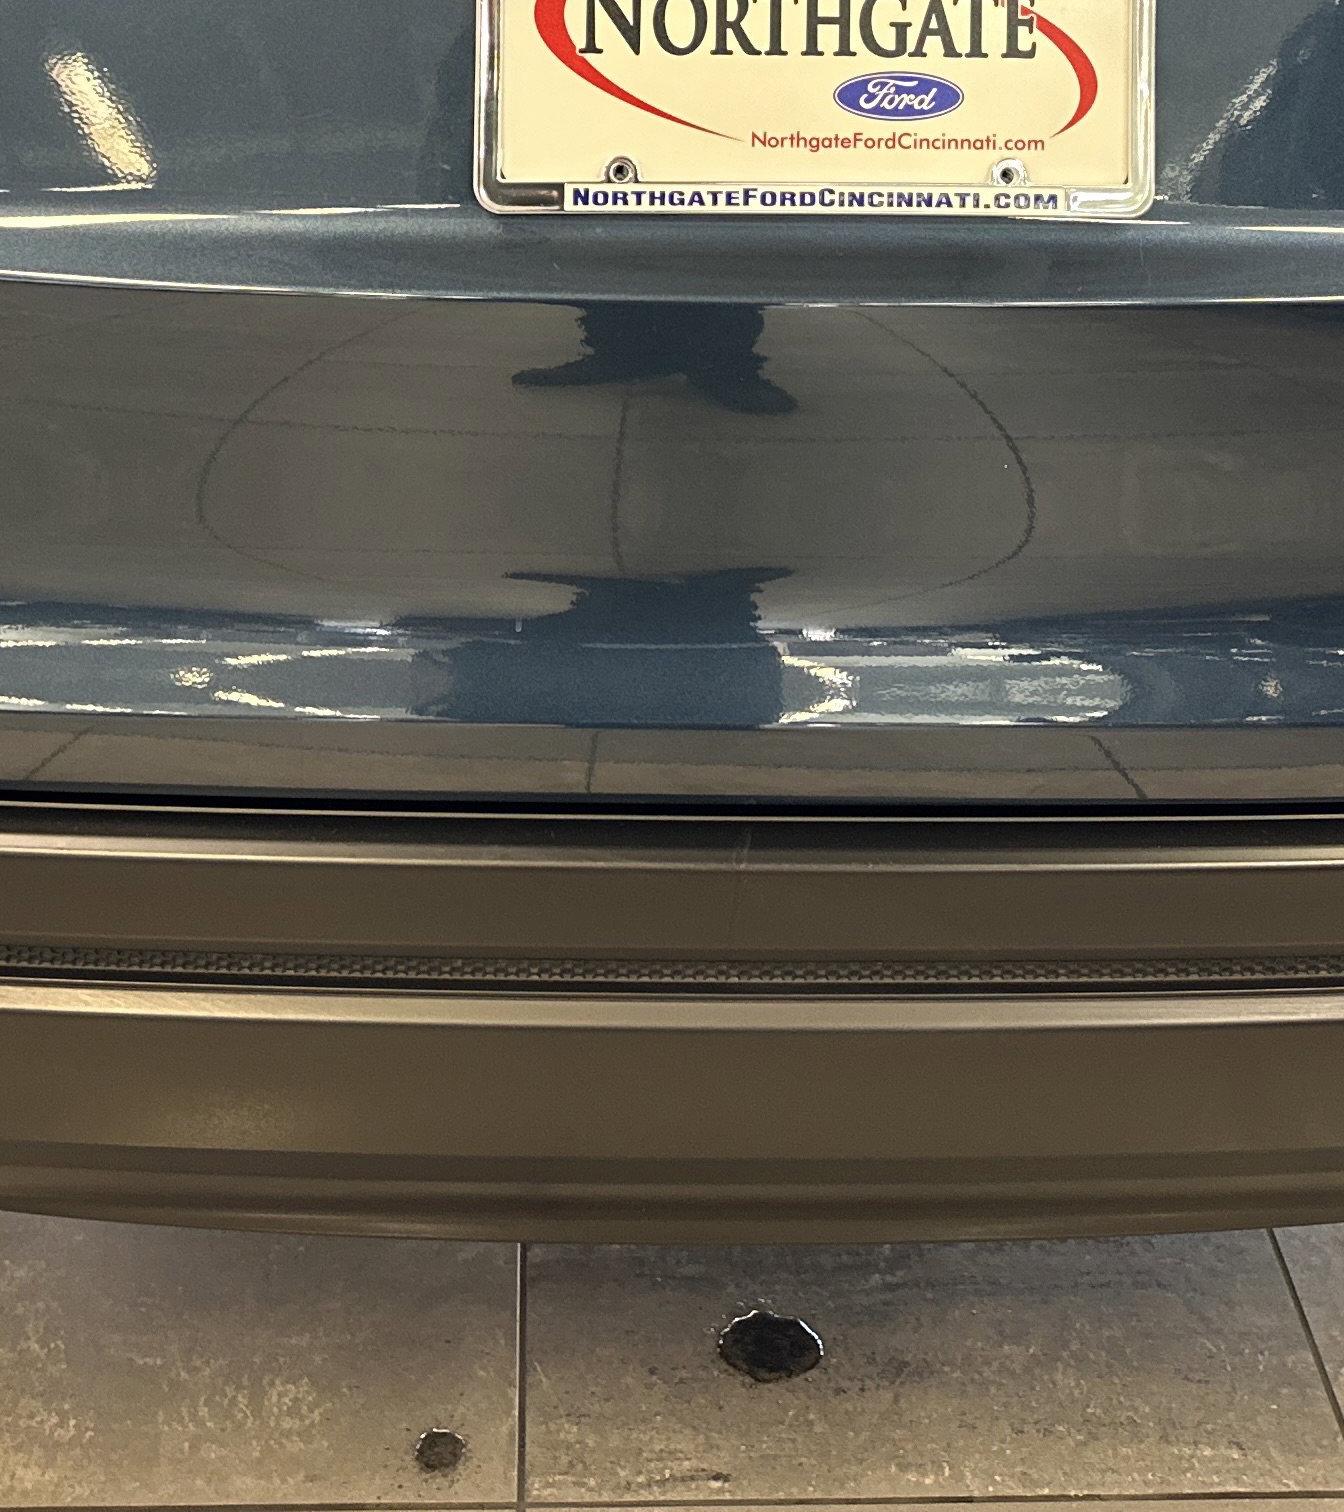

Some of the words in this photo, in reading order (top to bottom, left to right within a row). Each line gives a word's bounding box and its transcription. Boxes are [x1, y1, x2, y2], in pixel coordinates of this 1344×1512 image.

[858, 79, 938, 110] Ford
[751, 131, 1045, 152] NorthgateFordCincinnati.com
[572, 188, 1059, 210] NORTHGATEFORDCINCINNATI.COM
